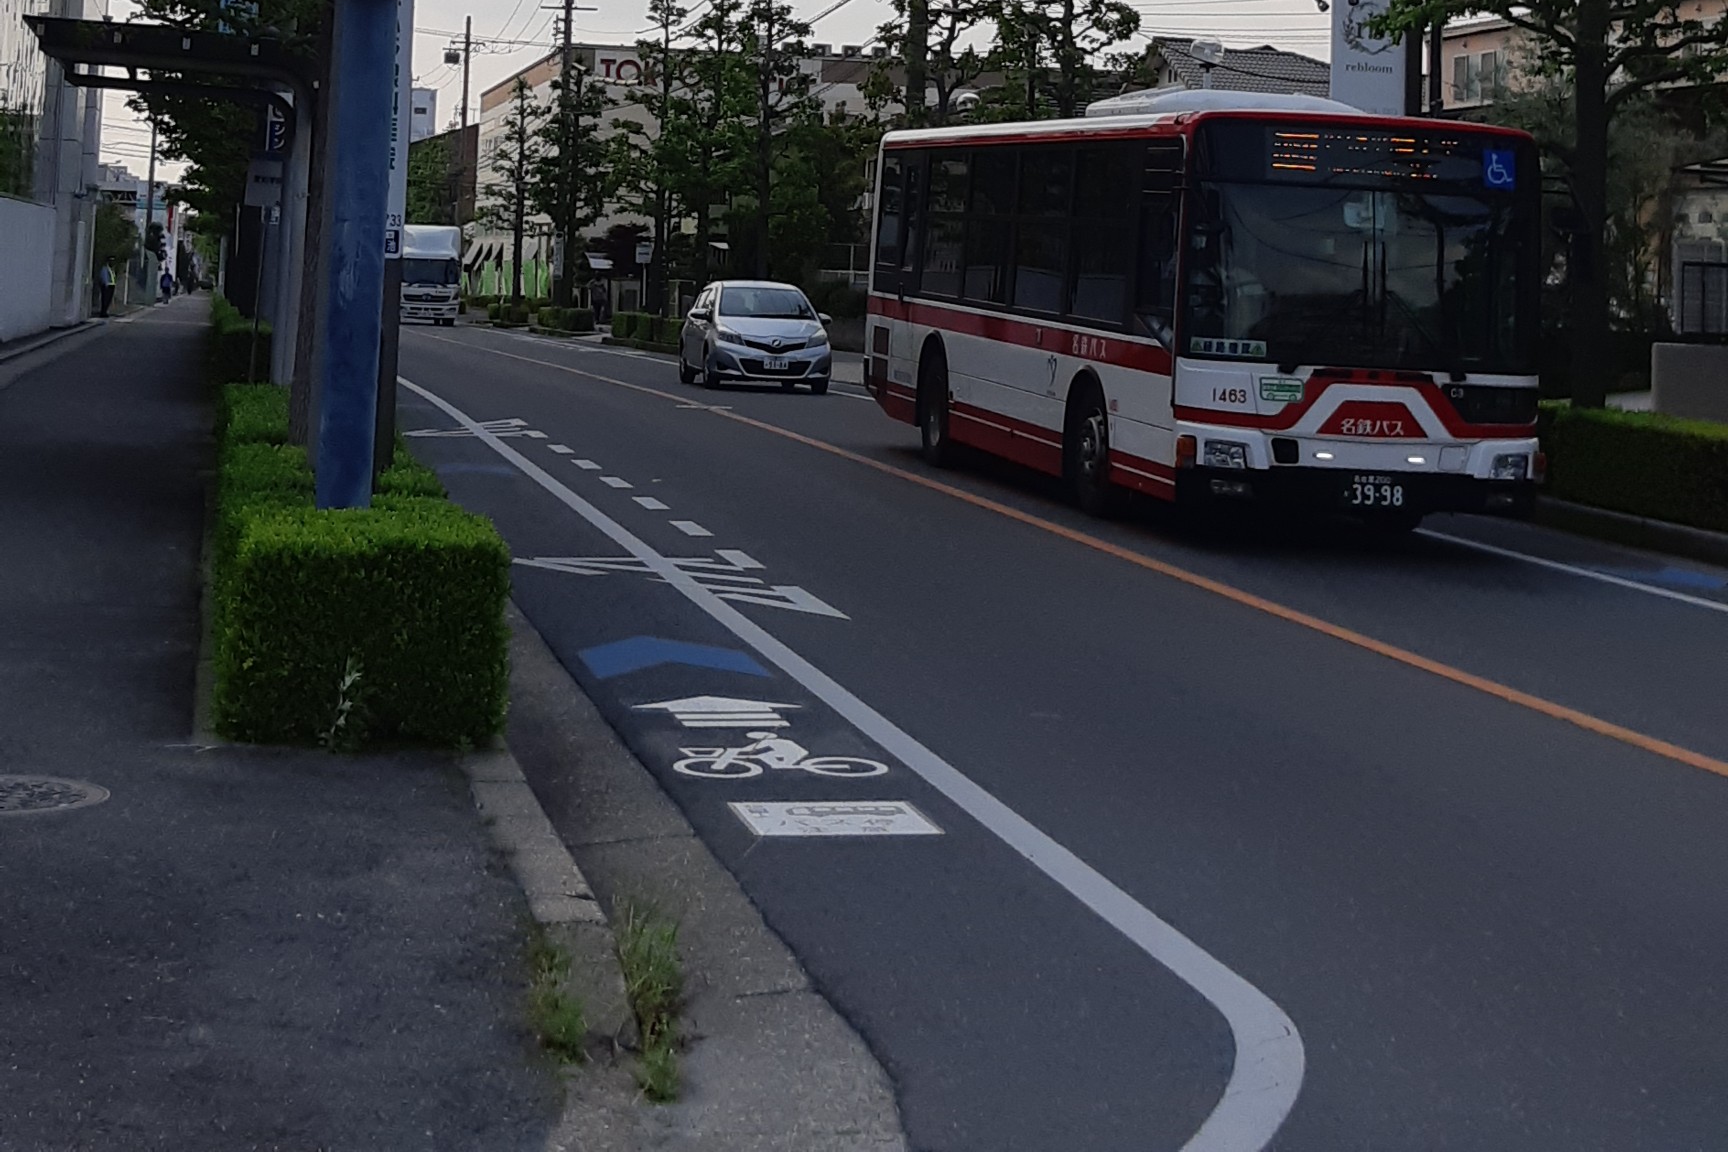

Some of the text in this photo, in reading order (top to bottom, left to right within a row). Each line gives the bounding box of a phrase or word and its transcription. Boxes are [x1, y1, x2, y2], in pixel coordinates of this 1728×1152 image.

[1345, 62, 1393, 74] rebloom
[1212, 387, 1247, 404] 1463
[1340, 418, 1404, 436] 名鉄バス
[1352, 483, 1403, 506] 39-98
